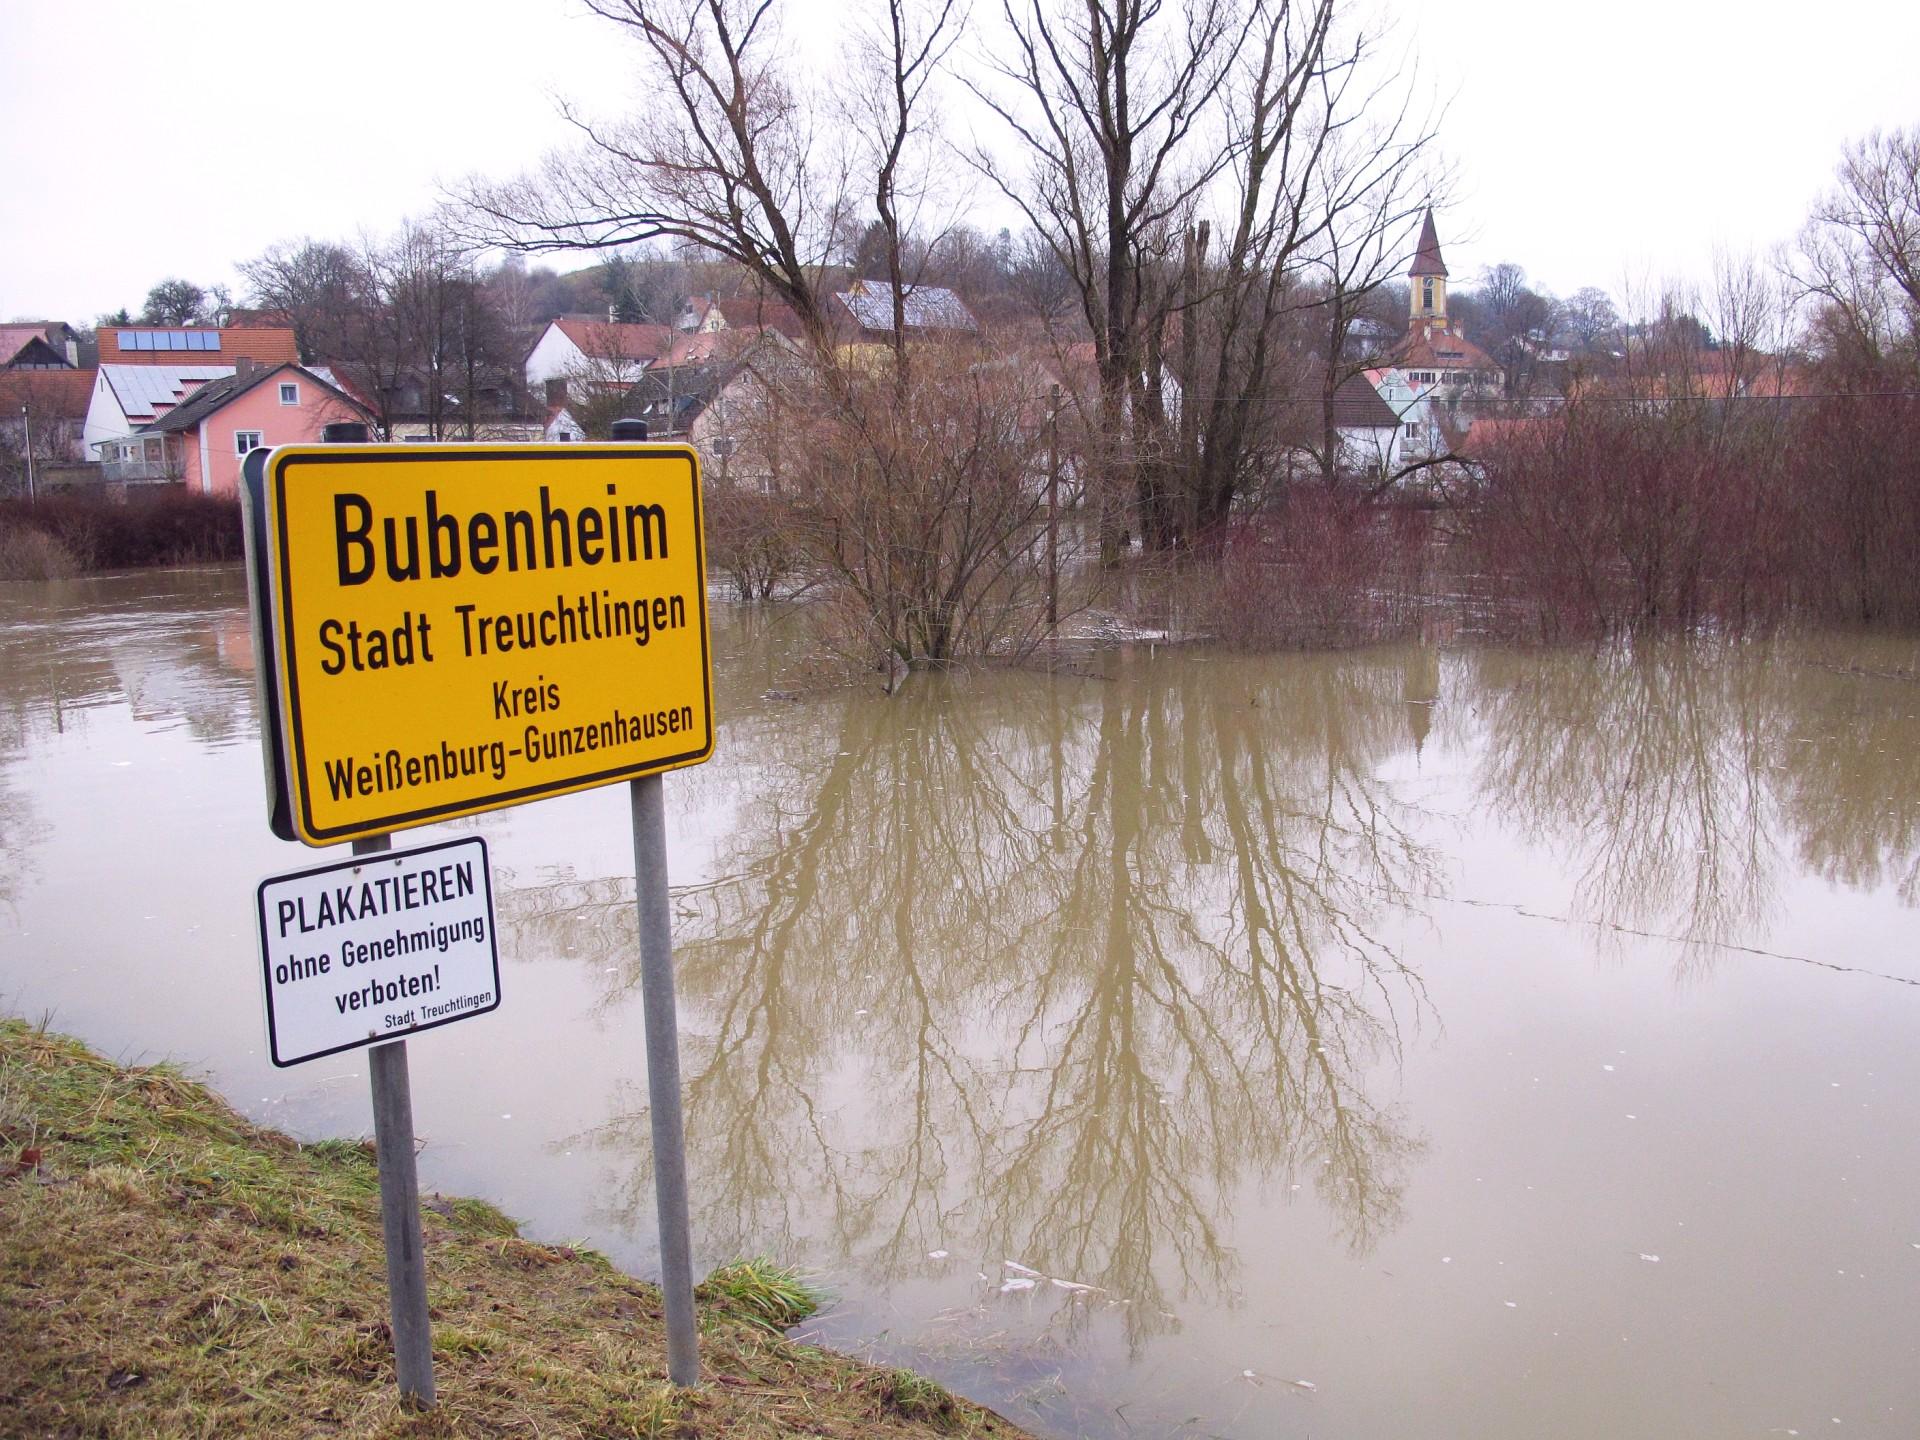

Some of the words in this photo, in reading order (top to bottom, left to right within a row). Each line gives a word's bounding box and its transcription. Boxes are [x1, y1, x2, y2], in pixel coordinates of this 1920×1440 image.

[333, 484, 669, 587] Bubenheim
[318, 611, 434, 676] Stadt
[455, 590, 686, 658] Treuchtlingen
[493, 675, 561, 720] Kreis
[324, 705, 694, 802] Weißenburg-Gunzenhausen
[278, 861, 474, 938] PLAKATIEREN
[276, 954, 331, 985] ohne
[341, 916, 485, 968] Genehmigung
[335, 964, 441, 1014] verboten!
[385, 1010, 416, 1029] Stadt
[420, 991, 492, 1020] Treuchtlingen
